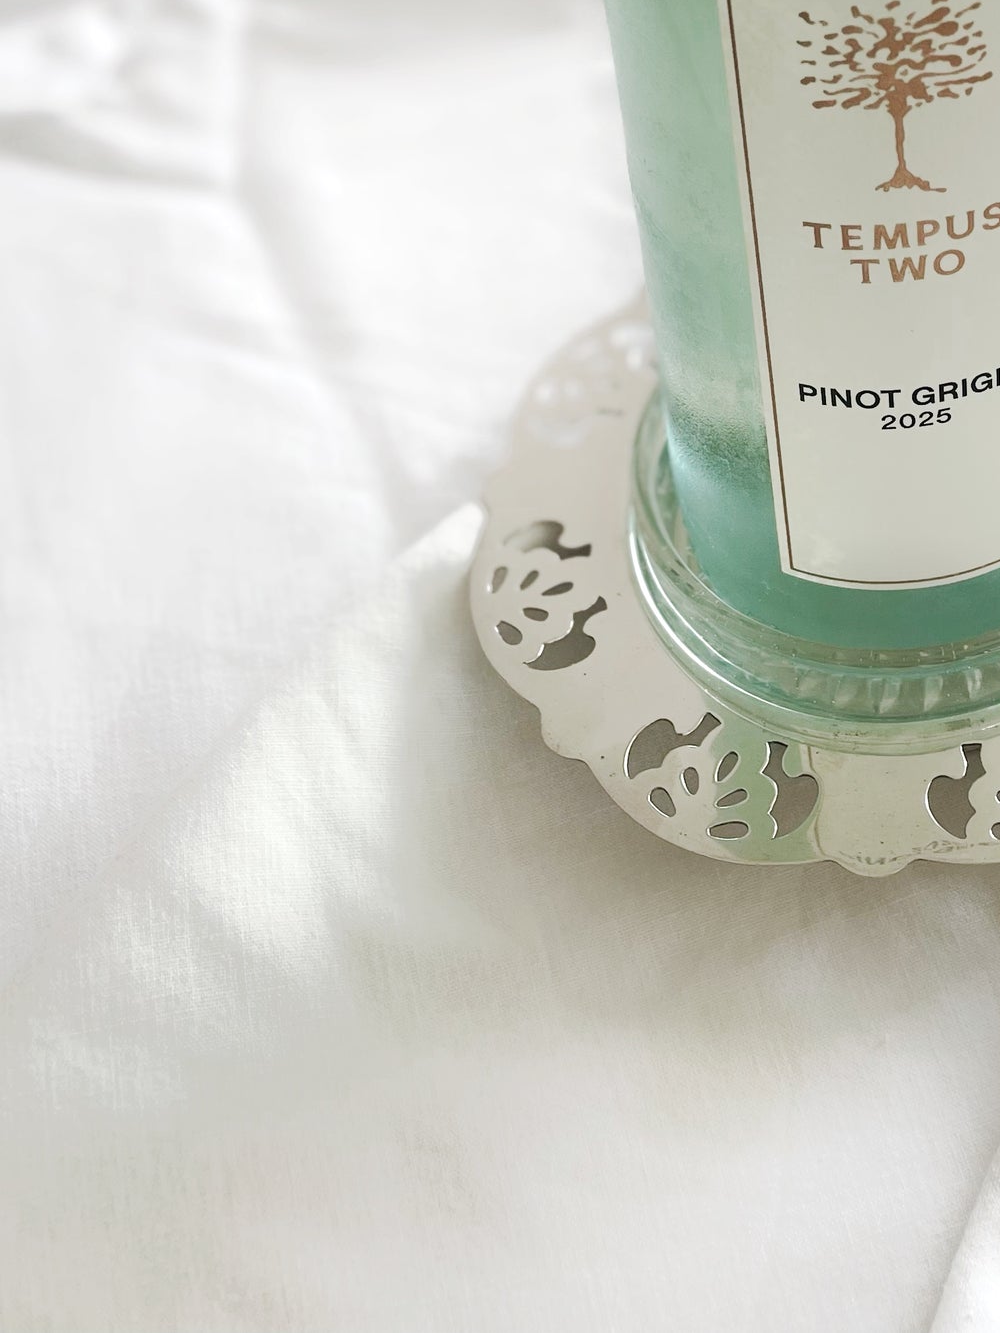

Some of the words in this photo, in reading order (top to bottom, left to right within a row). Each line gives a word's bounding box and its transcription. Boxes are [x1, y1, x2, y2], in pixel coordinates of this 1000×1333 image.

[850, 249, 966, 284] TWO
[798, 383, 902, 409] PINOT
[881, 408, 952, 430] 2025
